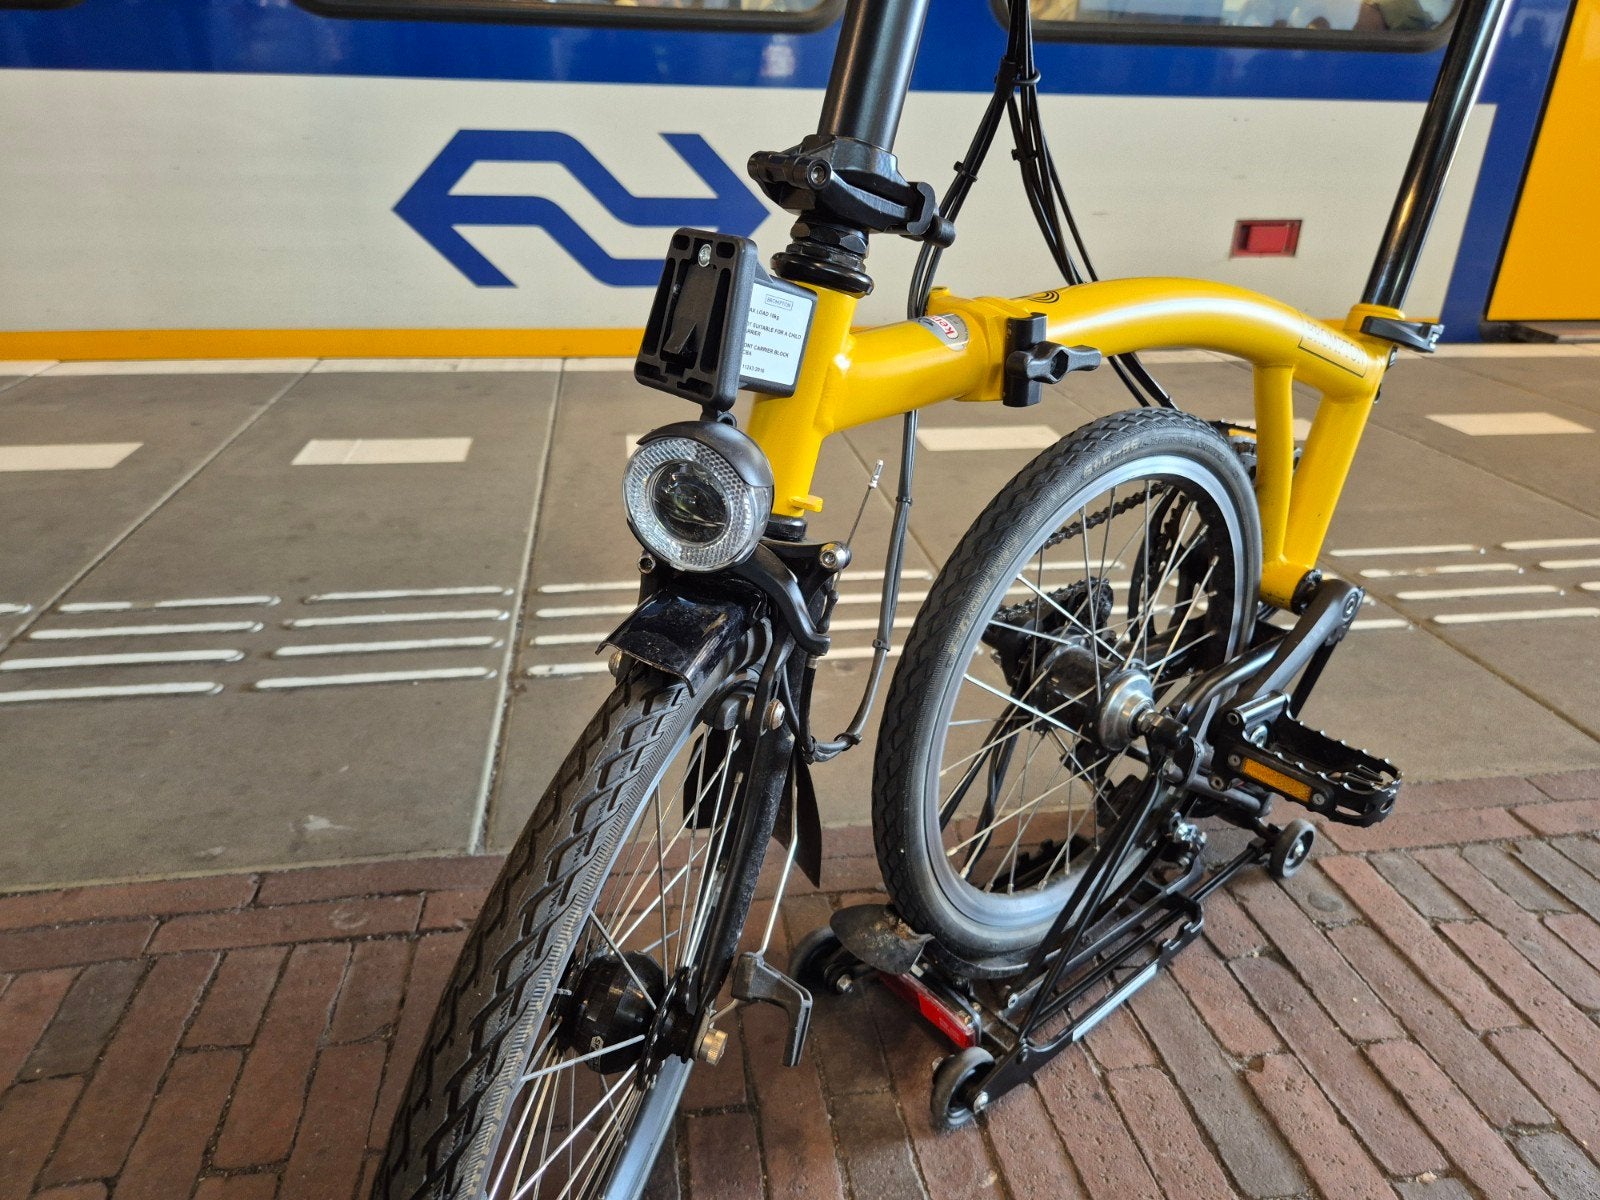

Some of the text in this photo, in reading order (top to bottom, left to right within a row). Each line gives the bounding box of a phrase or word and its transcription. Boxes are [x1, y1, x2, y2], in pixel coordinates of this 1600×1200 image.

[753, 322, 774, 333] SUITABLE
[754, 345, 773, 353] CARRIER
[774, 349, 789, 358] BLOCK
